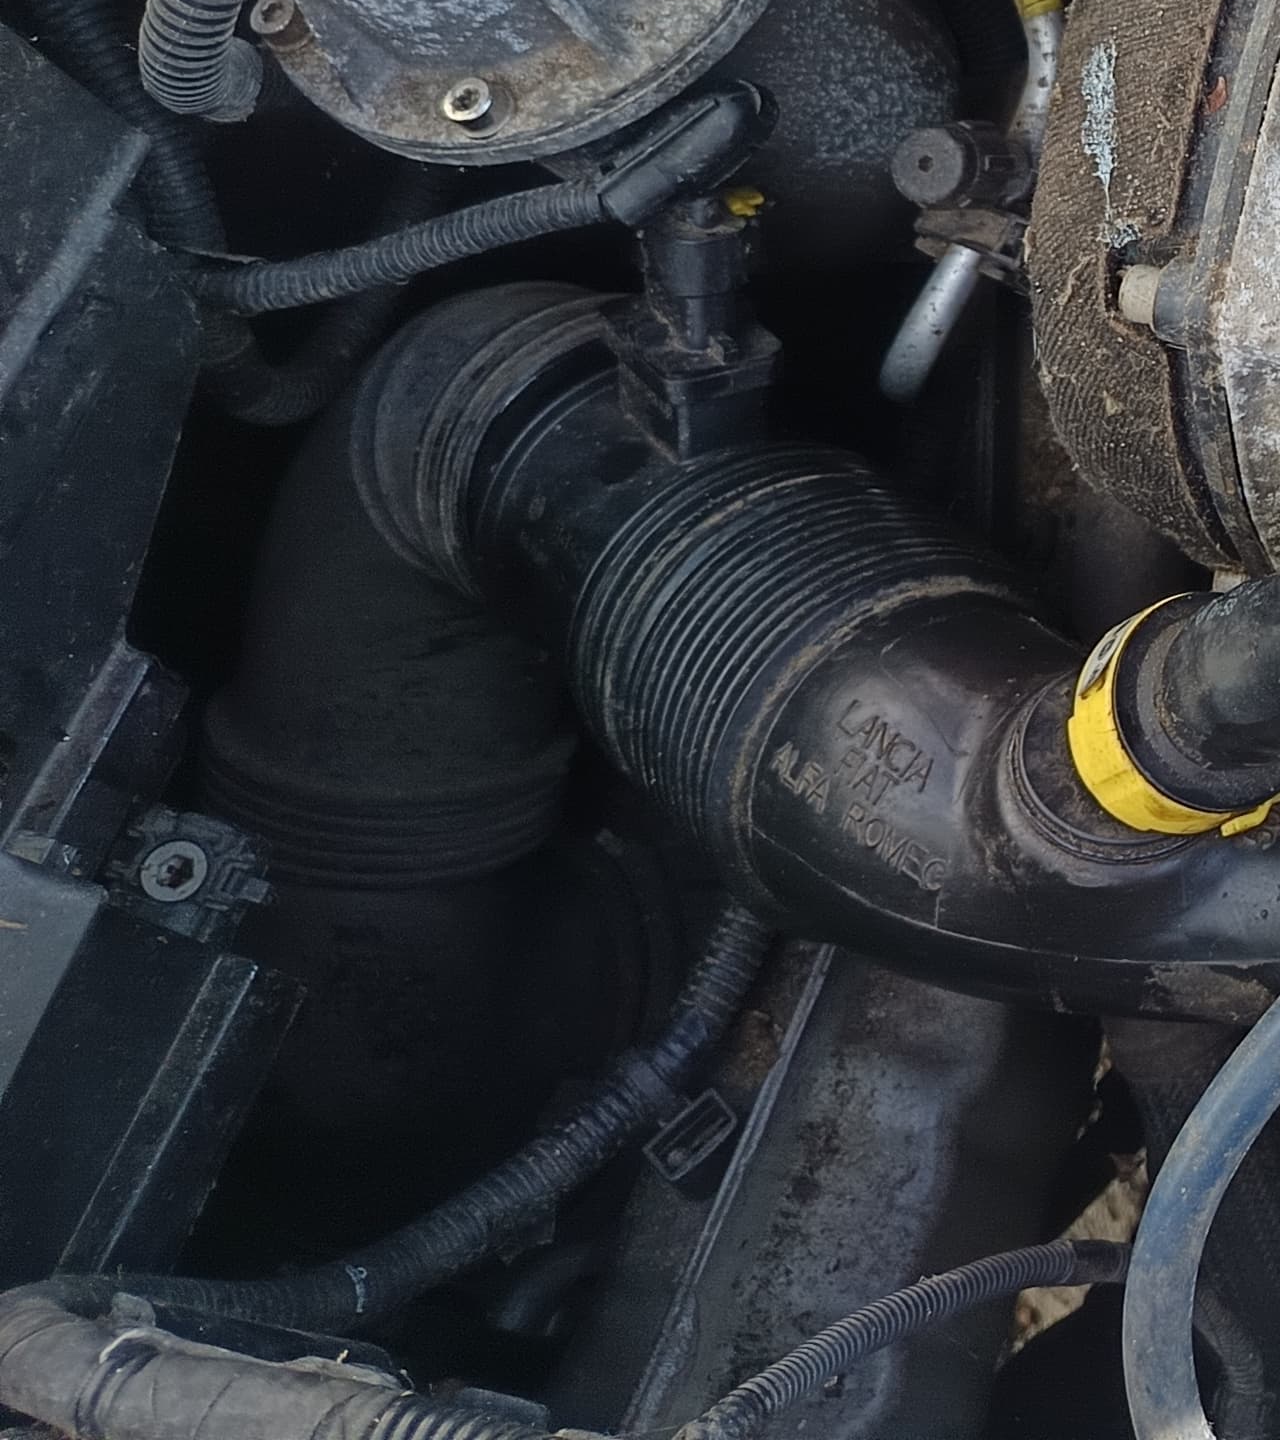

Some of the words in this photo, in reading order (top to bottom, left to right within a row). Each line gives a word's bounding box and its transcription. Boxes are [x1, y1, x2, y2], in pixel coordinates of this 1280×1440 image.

[771, 740, 830, 815] ALFA
[833, 747, 900, 806] FIAT
[837, 698, 935, 793] LANCIA
